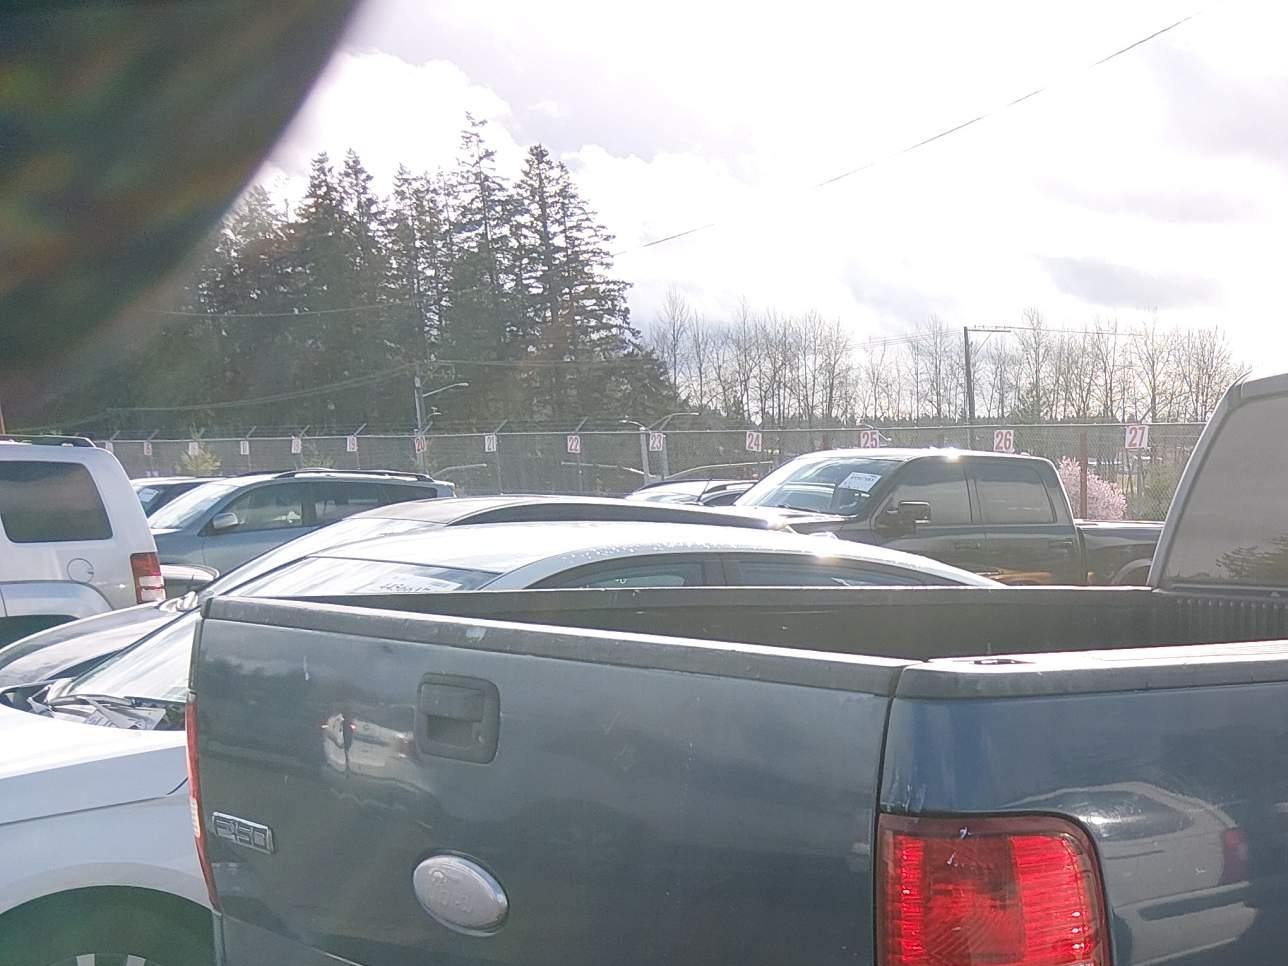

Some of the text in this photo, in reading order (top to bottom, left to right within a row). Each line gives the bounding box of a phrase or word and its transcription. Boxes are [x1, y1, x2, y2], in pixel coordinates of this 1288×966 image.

[486, 436, 496, 451] 21
[568, 436, 580, 452] 22
[651, 434, 663, 450] 23
[747, 433, 761, 450] 24
[863, 432, 878, 448] 25
[995, 431, 1013, 450] 26
[1128, 427, 1146, 448] 27
